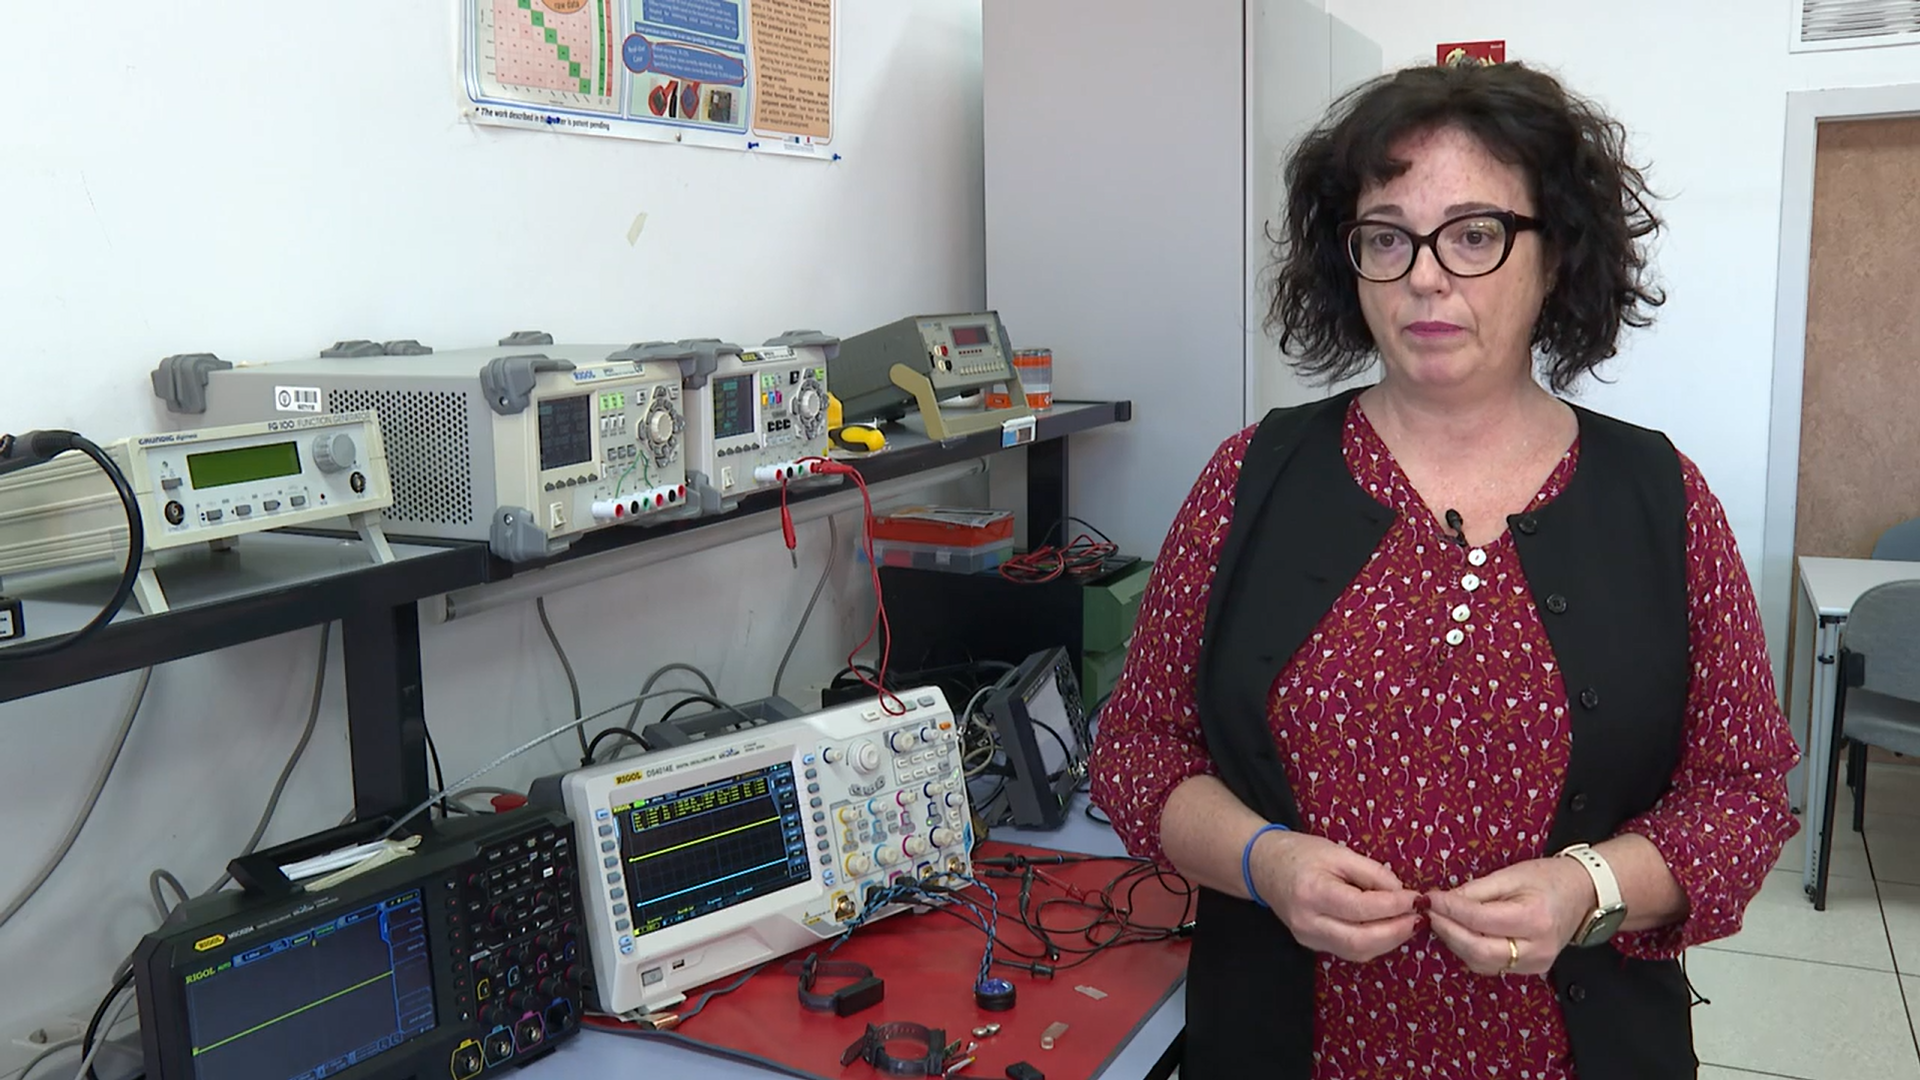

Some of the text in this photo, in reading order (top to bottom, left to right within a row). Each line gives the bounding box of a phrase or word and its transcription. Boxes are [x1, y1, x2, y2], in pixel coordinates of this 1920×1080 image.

[481, 107, 493, 117] The
[494, 110, 508, 119] work
[589, 121, 610, 131] pending
[267, 410, 371, 431] FG 100 FUNCTION GENERATOR
[138, 434, 175, 446] GRUNDIG
[616, 771, 642, 784] RIGOL
[185, 966, 216, 985] RIGOL
